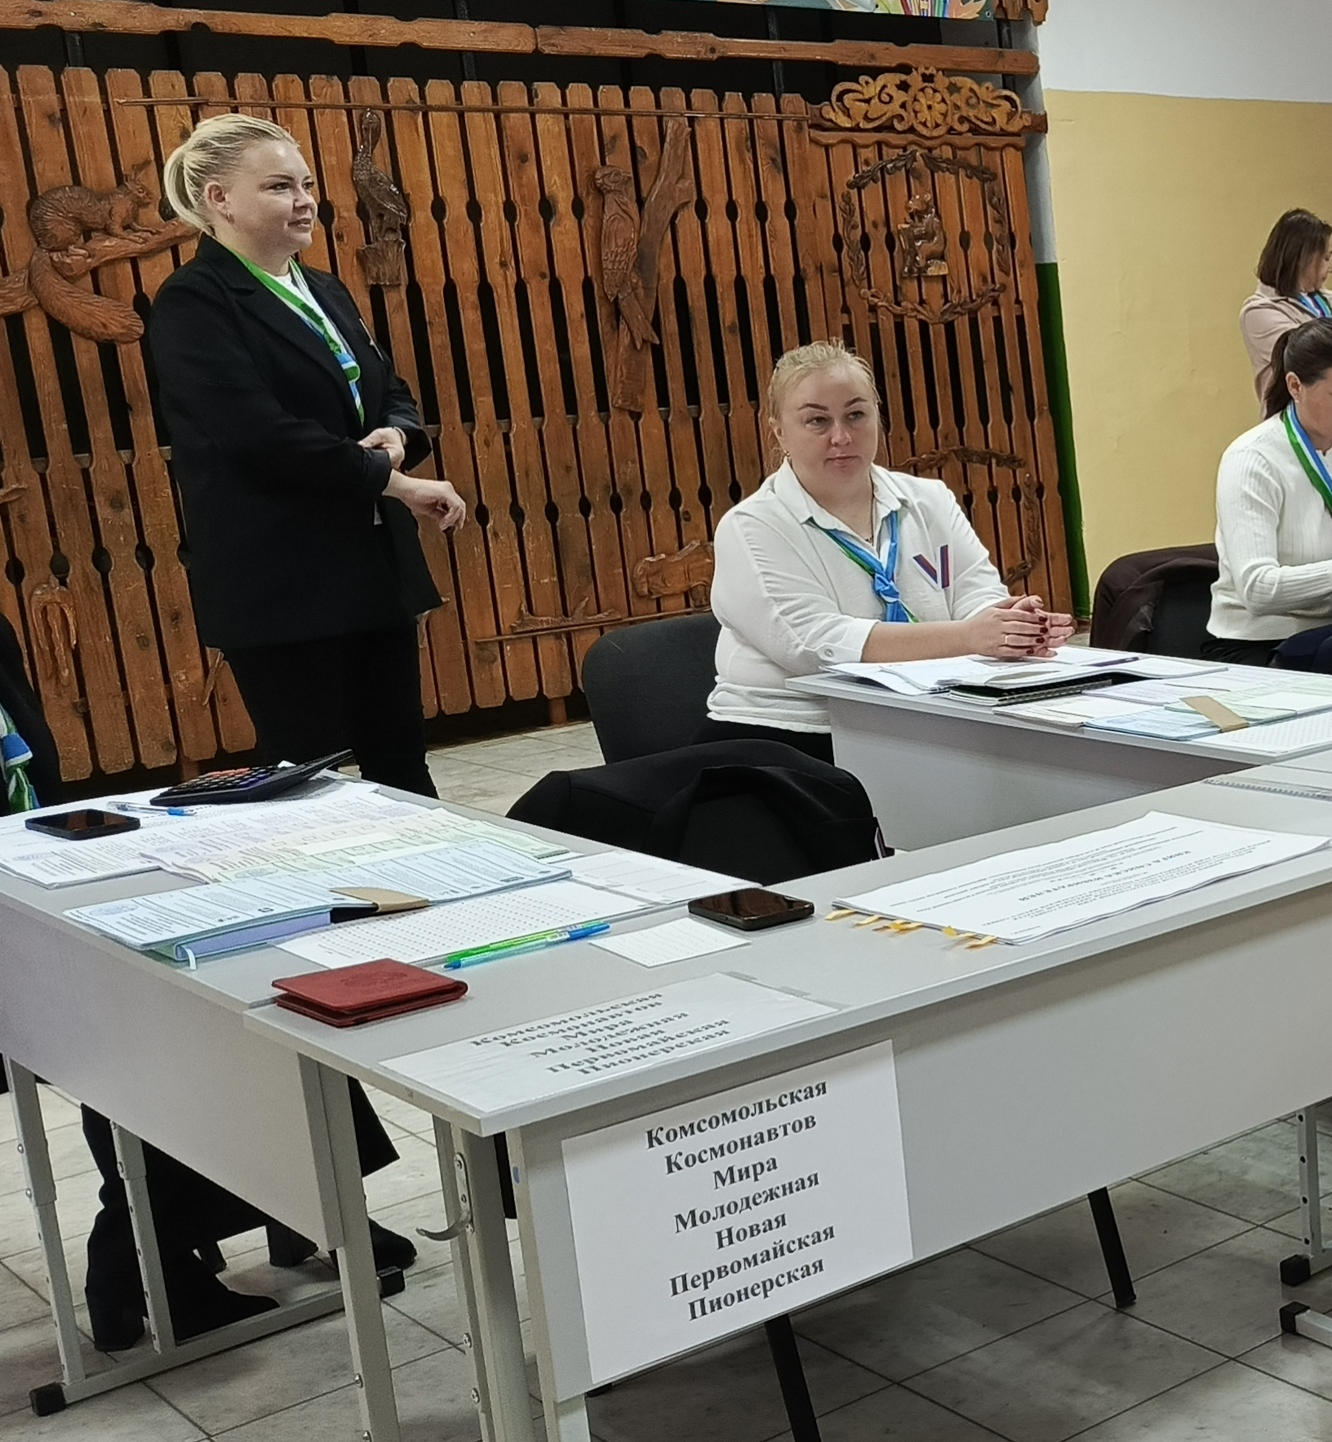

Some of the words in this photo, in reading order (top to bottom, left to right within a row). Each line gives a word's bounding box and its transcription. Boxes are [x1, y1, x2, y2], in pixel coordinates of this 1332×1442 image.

[470, 992, 664, 1047] Комсомольская
[500, 1001, 663, 1048] Космонавтов
[529, 1012, 690, 1059] Молодежная
[561, 1019, 634, 1042] Мира
[585, 1030, 667, 1054] Новая
[546, 1019, 731, 1074] Первомайская
[576, 1030, 732, 1076] Пионерская
[645, 1080, 828, 1150] Комсомольская
[664, 1114, 817, 1175] Космонавтов
[713, 1156, 778, 1190] Мира
[674, 1171, 820, 1234] Молодежная
[715, 1213, 787, 1250] Новая
[670, 1226, 836, 1297] Первомайская
[688, 1258, 825, 1321] Пионерская
